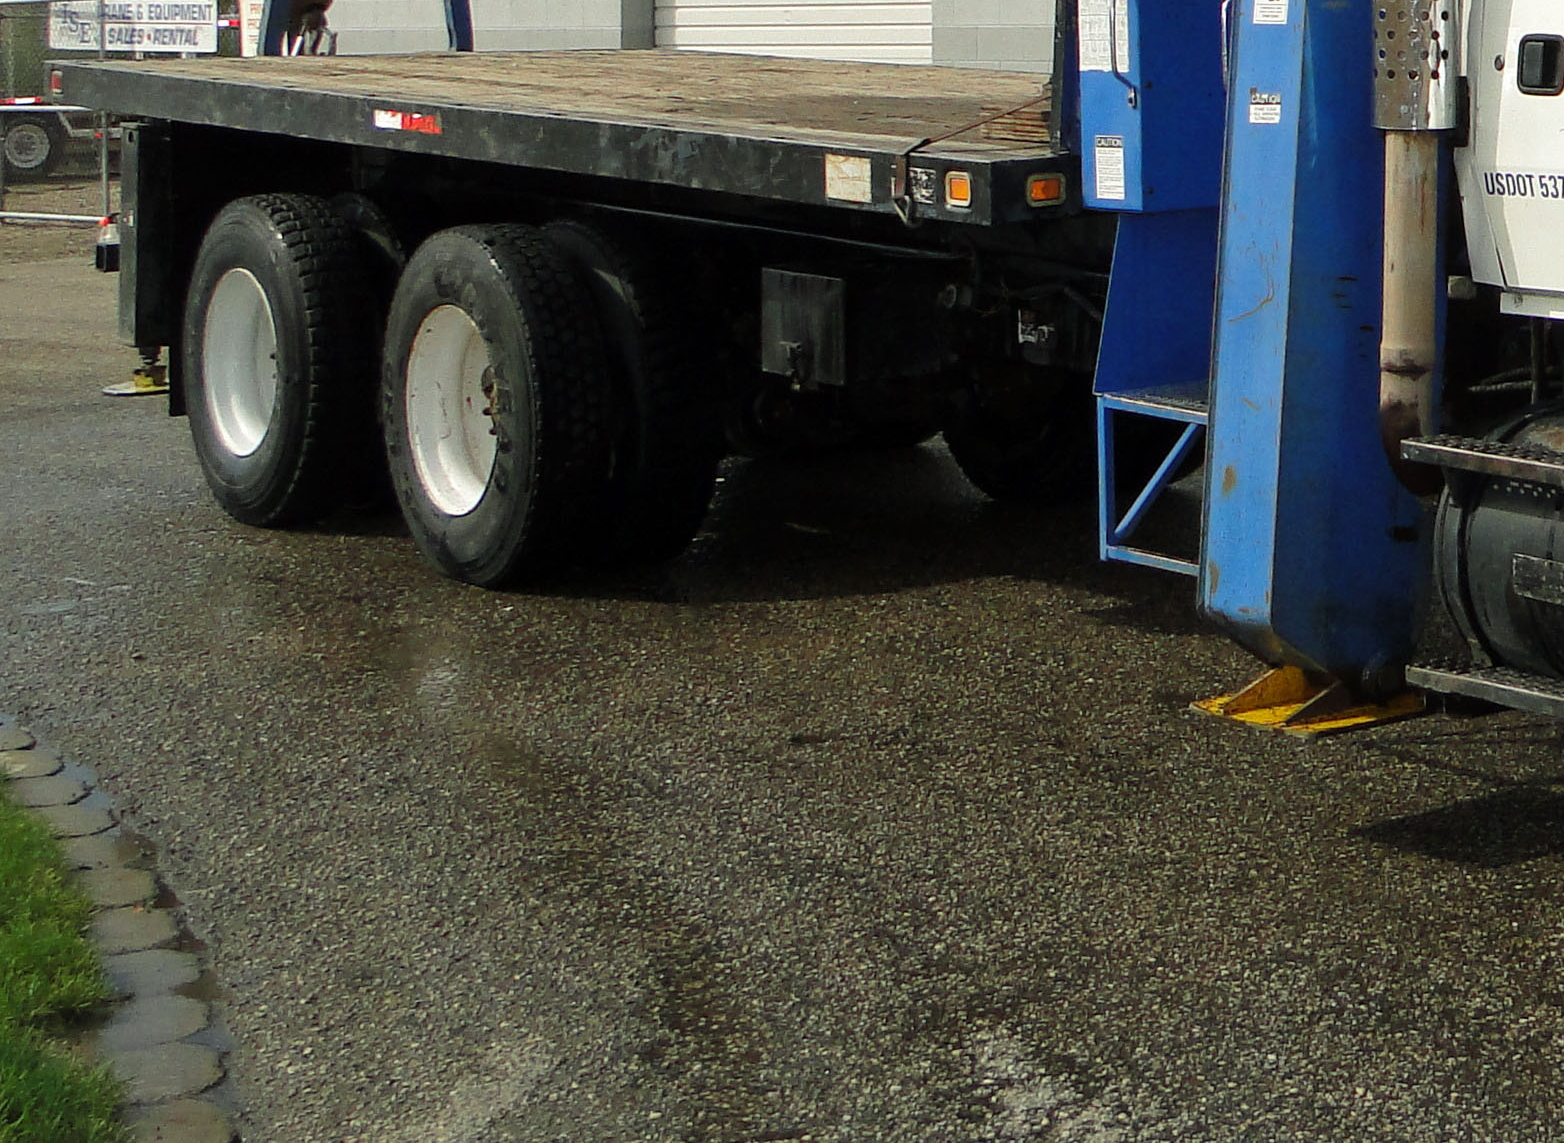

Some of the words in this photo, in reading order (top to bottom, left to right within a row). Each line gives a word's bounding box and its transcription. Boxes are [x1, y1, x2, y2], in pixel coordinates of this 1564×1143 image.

[101, 4, 133, 21] RANE
[149, 3, 213, 21] EQUIPMENT
[107, 27, 144, 45] SALES
[152, 28, 199, 46] RENTAL
[1484, 172, 1535, 198] USDOT
